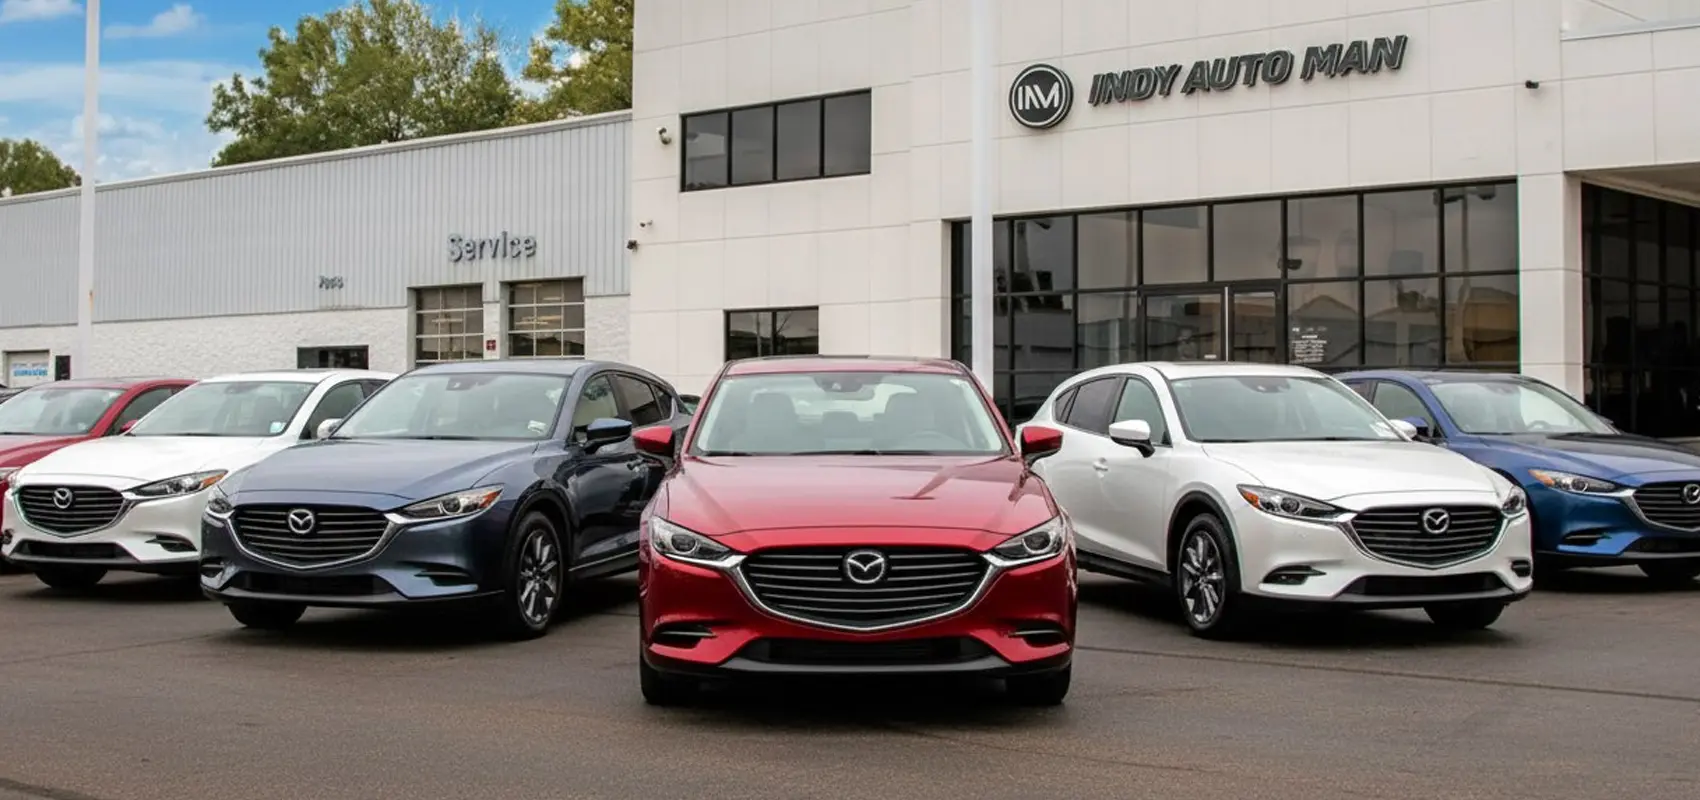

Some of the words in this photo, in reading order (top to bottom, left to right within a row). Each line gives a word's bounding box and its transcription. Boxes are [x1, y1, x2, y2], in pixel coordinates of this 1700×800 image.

[1088, 64, 1182, 106] INDY
[1182, 50, 1294, 95] AUTO
[1300, 35, 1408, 81] MAN
[448, 231, 537, 263] Service
